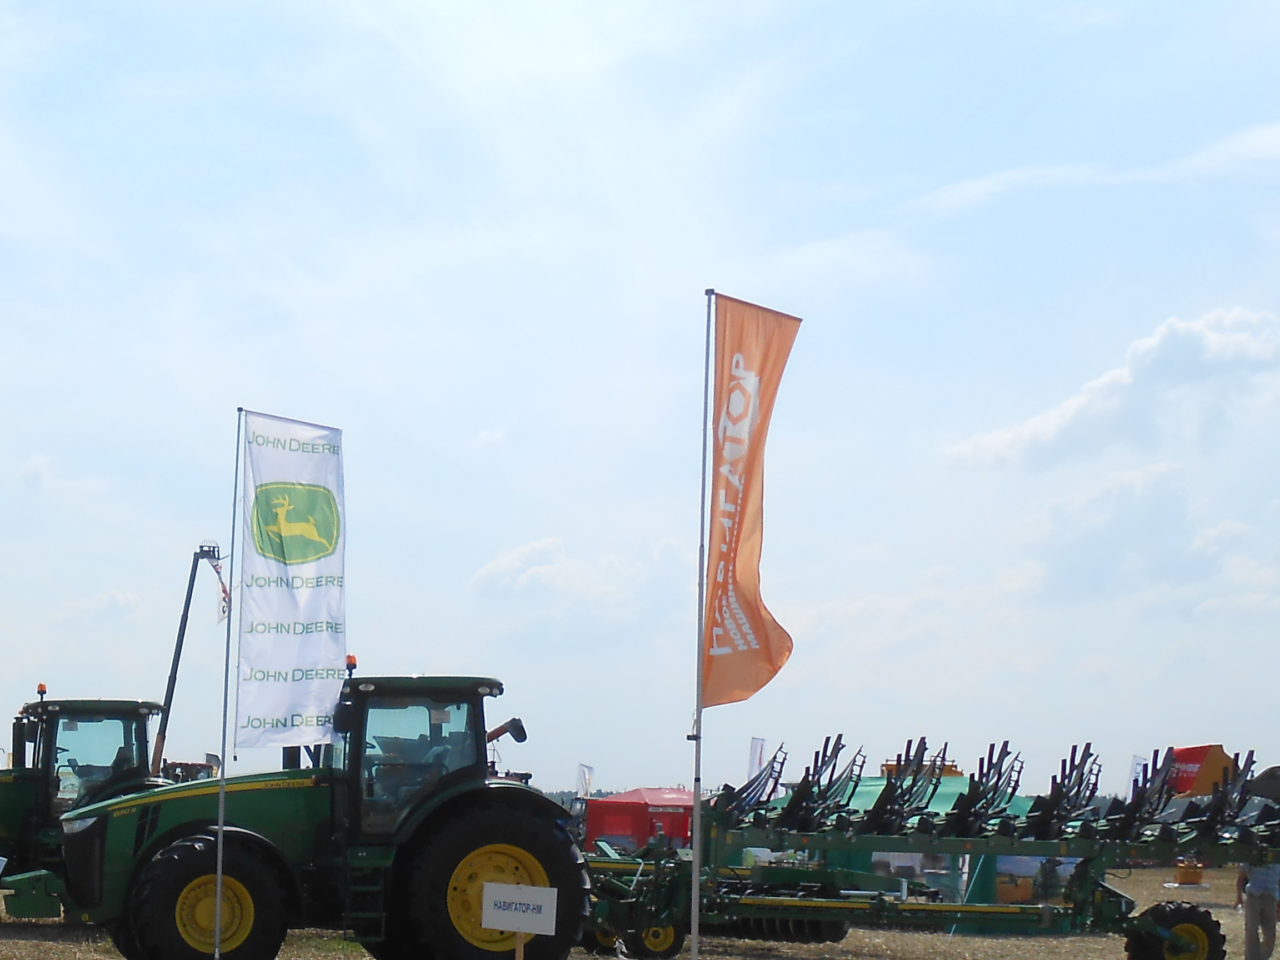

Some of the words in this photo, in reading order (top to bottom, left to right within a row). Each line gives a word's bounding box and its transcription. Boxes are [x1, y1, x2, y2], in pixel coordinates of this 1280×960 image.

[248, 431, 287, 451] JOHN
[288, 438, 340, 456] DEERE
[246, 574, 289, 589] JOHN
[291, 575, 343, 590] DEERE
[244, 620, 291, 635] JOHN
[292, 620, 344, 636] DEERE
[243, 667, 288, 682] JOHN
[291, 668, 346, 682] DEERE
[240, 715, 288, 729] JOHN
[290, 713, 334, 728] DEER
[493, 900, 543, 914] НАВИГАТОР-НМ
